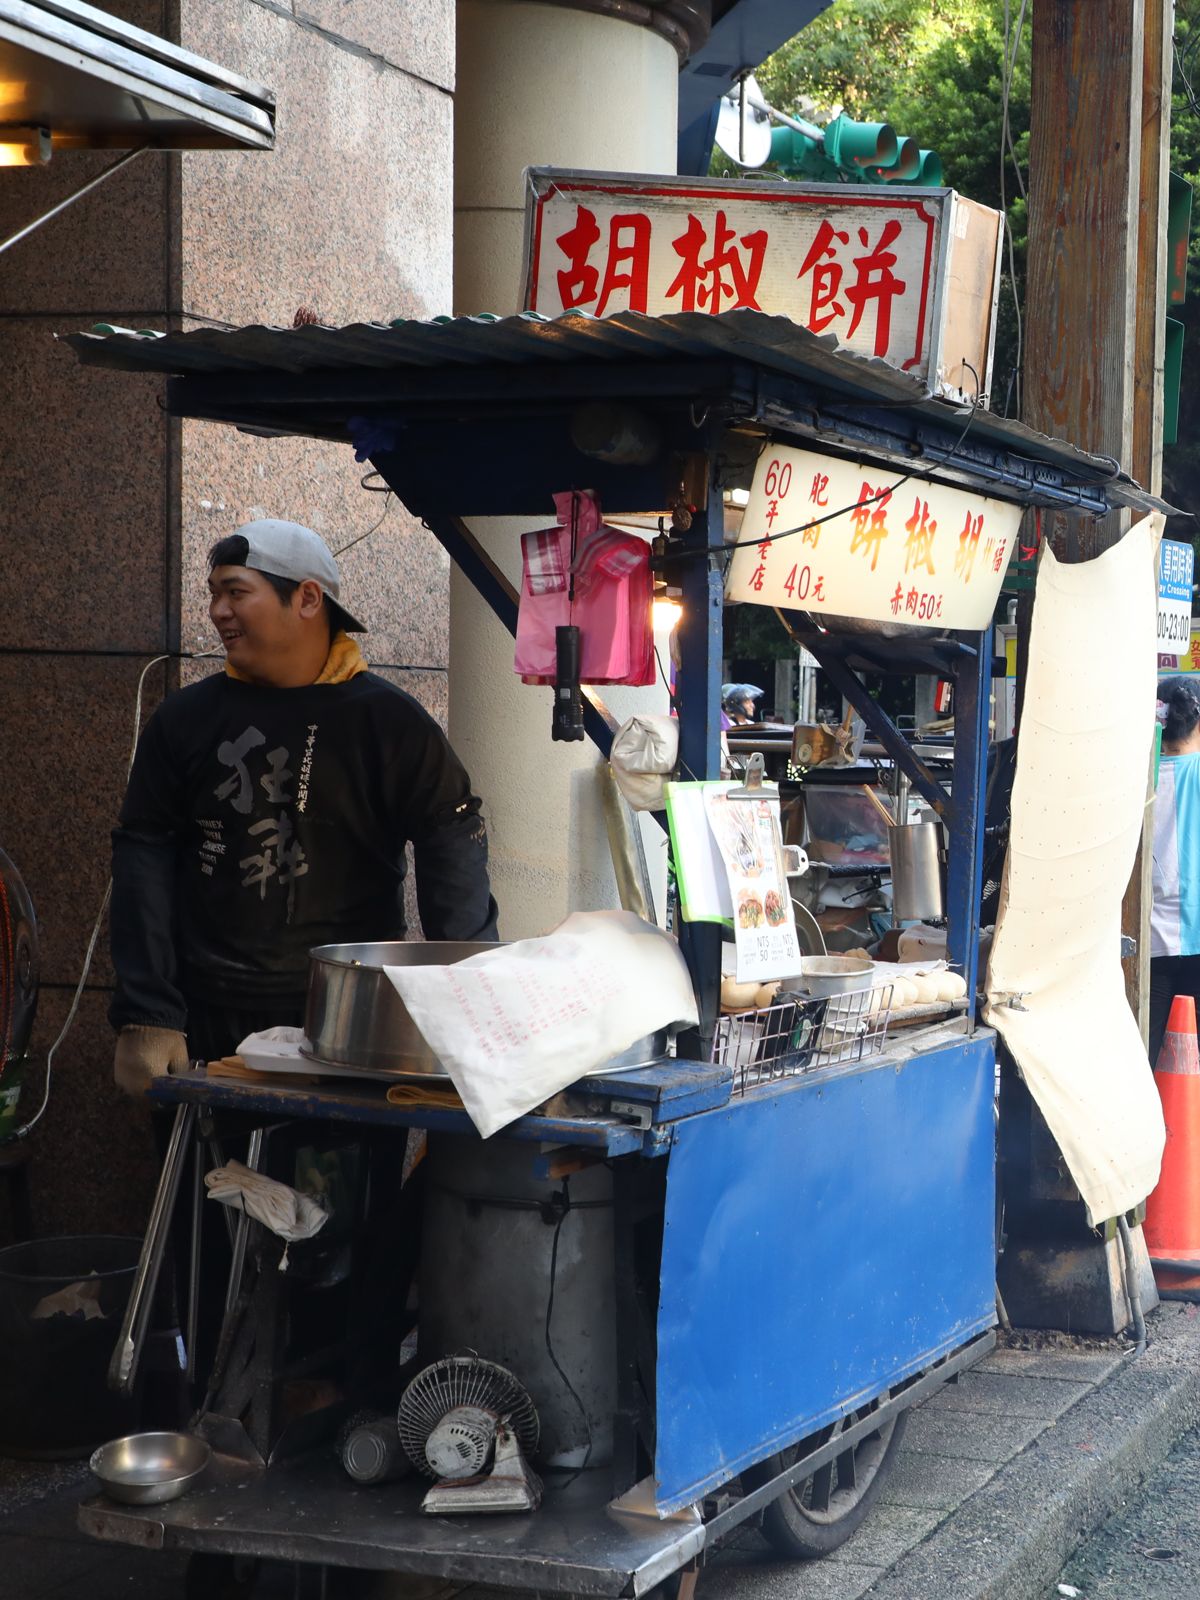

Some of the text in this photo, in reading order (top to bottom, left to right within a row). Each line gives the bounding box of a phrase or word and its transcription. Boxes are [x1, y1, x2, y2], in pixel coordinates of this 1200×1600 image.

[556, 204, 906, 358] 胡椒餅
[783, 472, 830, 603] 肥肉 40元
[890, 581, 944, 621] 赤肉50元
[1167, 584, 1190, 600] Crossing
[1157, 611, 1189, 642] 00-23:00
